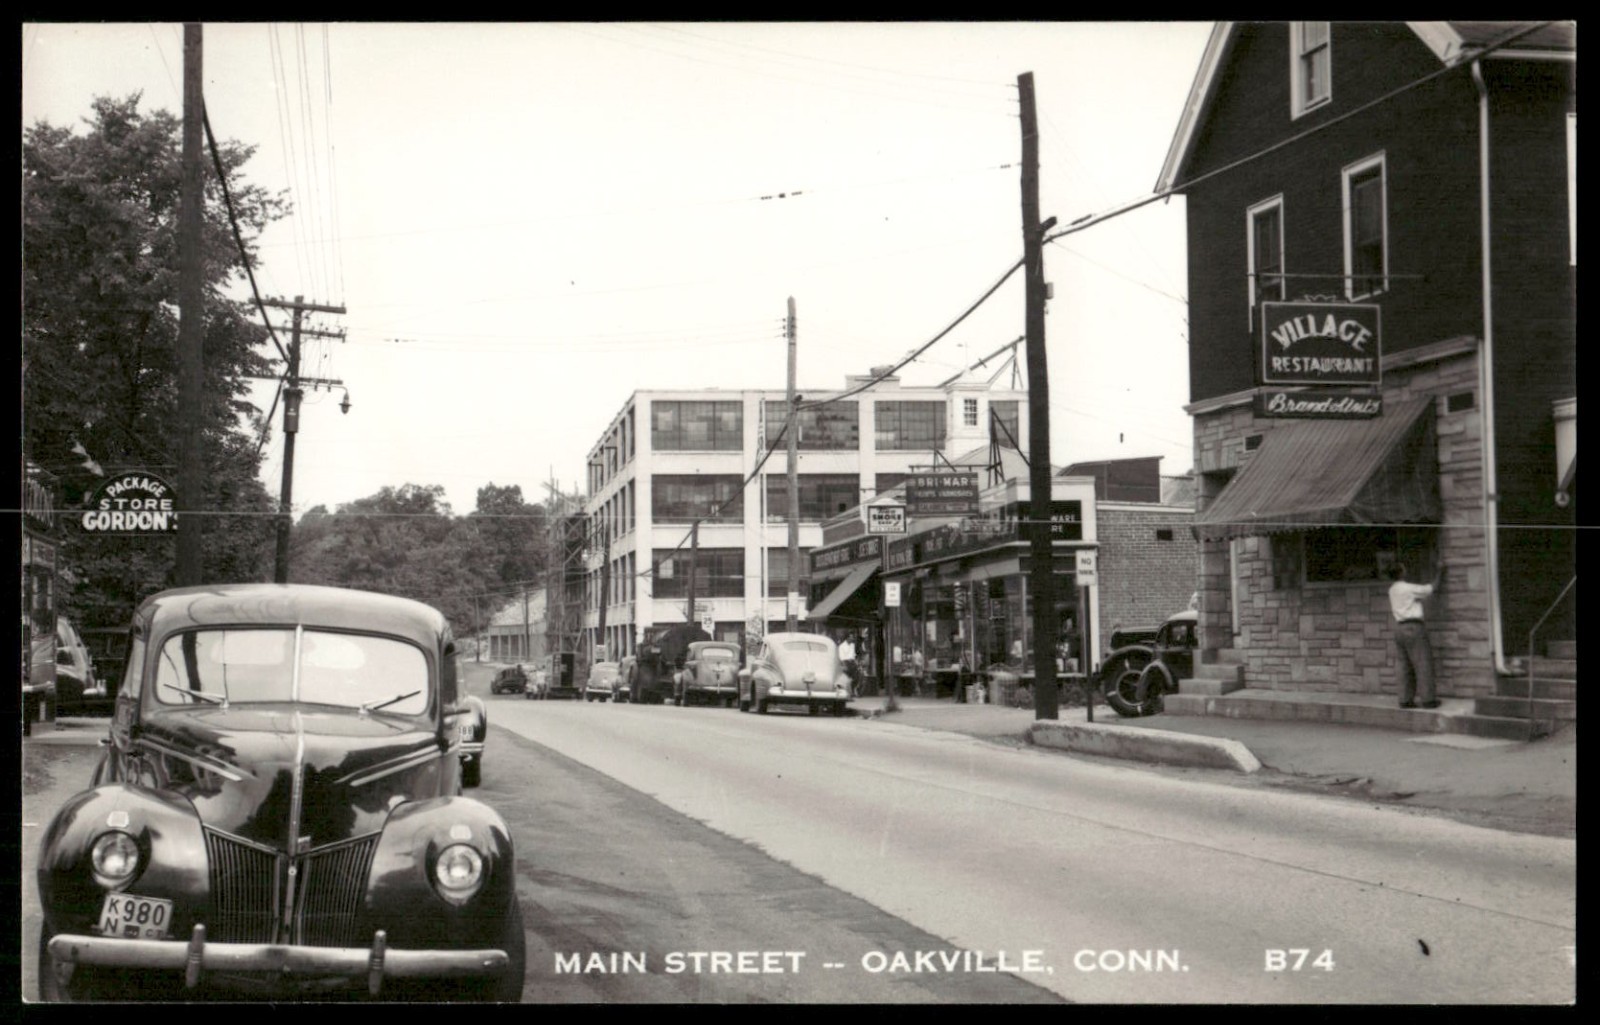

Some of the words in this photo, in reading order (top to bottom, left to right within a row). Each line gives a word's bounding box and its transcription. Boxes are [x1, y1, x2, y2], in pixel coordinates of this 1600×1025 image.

[1271, 313, 1373, 352] VILLAGE
[1271, 356, 1374, 373] RESTAURANT
[105, 476, 167, 498] PACKAGE
[99, 498, 173, 511] STORE
[1081, 557, 1092, 566] NO
[123, 900, 165, 926] 980
